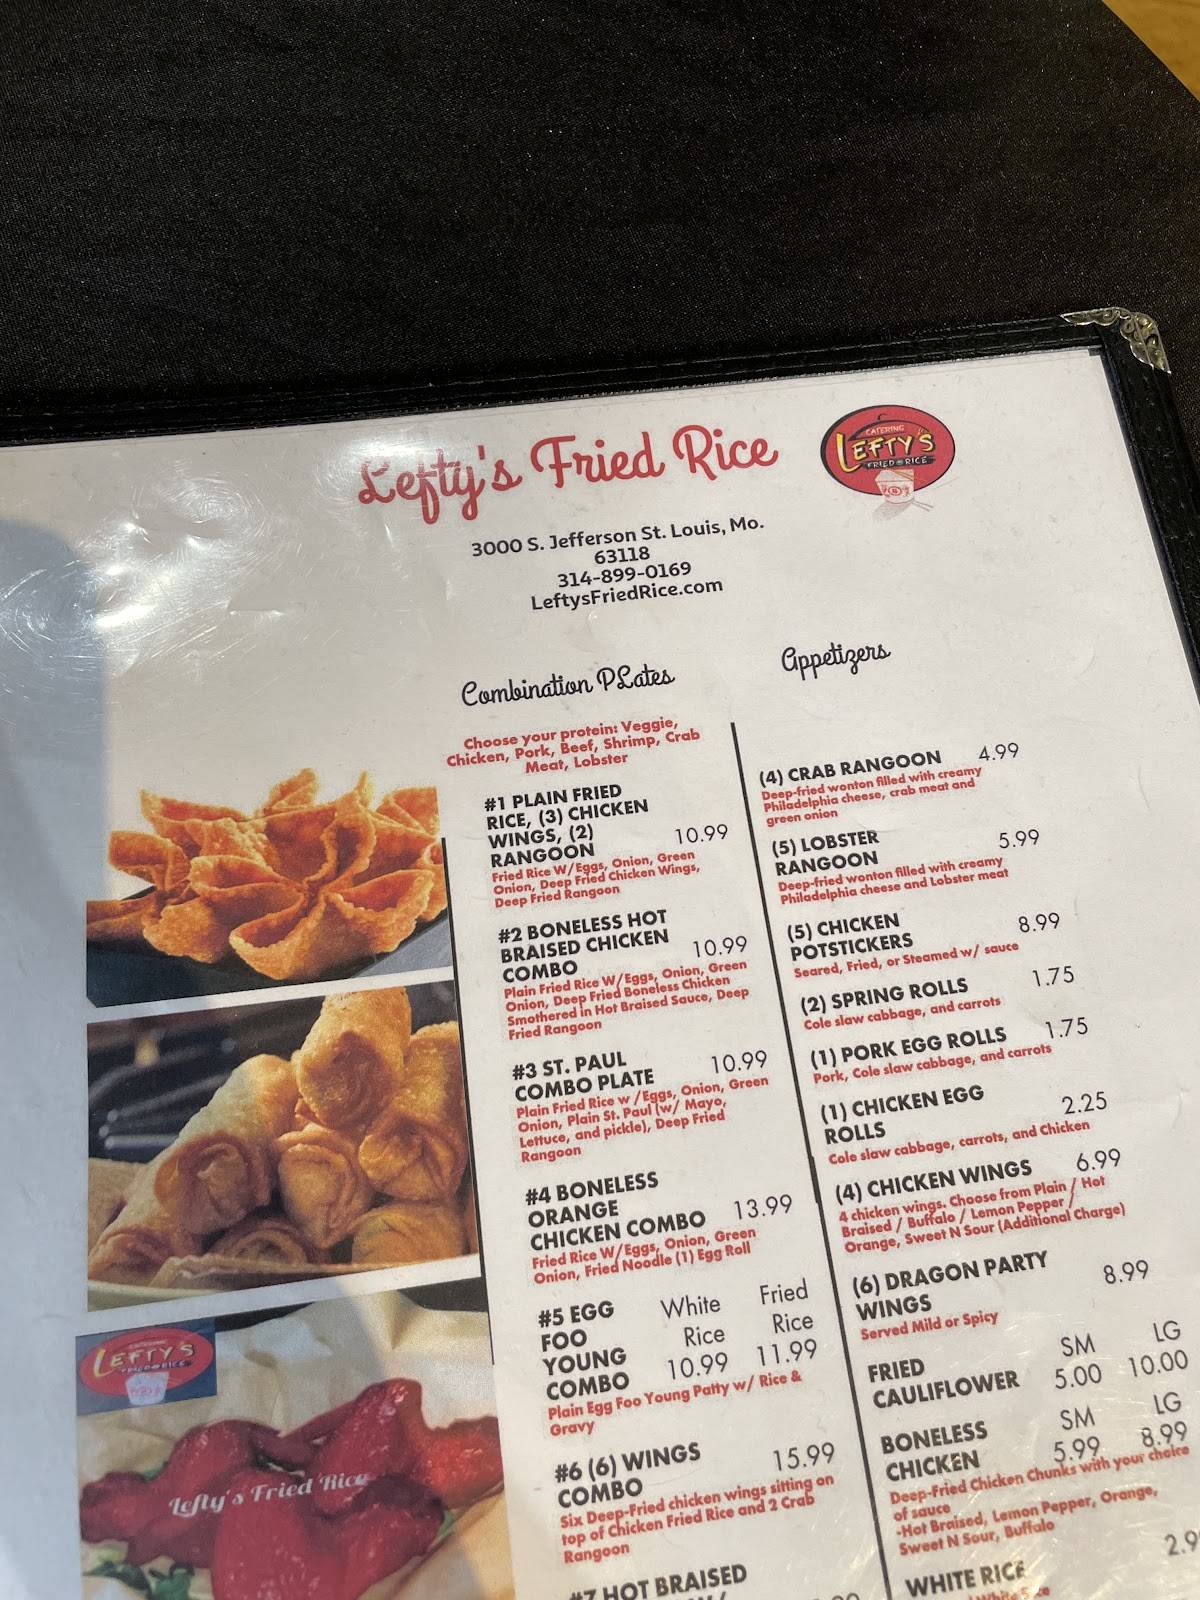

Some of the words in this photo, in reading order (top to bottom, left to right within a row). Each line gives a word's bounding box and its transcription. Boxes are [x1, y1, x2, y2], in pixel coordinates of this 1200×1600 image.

[837, 428, 936, 472] LEFTY'S
[357, 446, 523, 526] Lefty's
[530, 431, 666, 489] Fried
[672, 424, 779, 481] Rice
[471, 539, 523, 557] 3000
[528, 536, 545, 553] S.
[548, 527, 637, 552] Jefferson
[642, 524, 666, 541] St.
[670, 518, 727, 539] Louis,
[730, 515, 765, 534] Mo.
[594, 546, 650, 564] 63118
[557, 561, 692, 588] 314-899-0169
[531, 578, 724, 611] LeftysFriedRice.com
[462, 666, 594, 707] Combination
[447, 752, 509, 767] Chicken,
[515, 745, 554, 760] Pork,
[561, 739, 597, 754] Beef,
[604, 733, 660, 750] Shrimp,
[666, 729, 700, 742] Crab
[463, 736, 518, 750] Choose
[522, 731, 557, 746] your
[560, 725, 618, 742] protein:
[621, 717, 678, 735] Veggie,
[525, 759, 569, 774] Meat,
[574, 753, 628, 768] Lobster
[760, 769, 783, 787] (4)
[788, 765, 836, 782] CRAB
[840, 751, 942, 776] RANGOON
[979, 743, 1019, 761] 4.99
[485, 798, 505, 811] #1
[513, 790, 568, 808] PLAIN
[573, 784, 622, 801] FRIED
[762, 784, 825, 800] Deep-fried
[828, 780, 873, 792] wonton
[876, 773, 906, 787] filled
[908, 770, 935, 782] with
[938, 766, 982, 780] creamy
[486, 813, 531, 830] RICE,
[539, 809, 563, 826] (3)
[568, 799, 649, 820] CHICKEN
[489, 829, 561, 848] WINGS,
[569, 824, 593, 842] (2)
[491, 844, 595, 867] RANGOON
[675, 824, 728, 844] 10.99
[772, 839, 796, 856] (5)
[801, 830, 879, 852] LOBSTER
[999, 829, 1039, 849] 5.99
[775, 851, 878, 876] RANGOON
[498, 928, 522, 943] #2
[528, 915, 623, 941] BONELESS
[628, 910, 667, 928] HOT
[787, 924, 811, 942] (5)
[817, 913, 900, 936] CHICKEN
[1018, 912, 1060, 933] 8.99
[501, 943, 581, 964] BRAISED
[586, 929, 669, 952] CHICKEN
[693, 936, 747, 958] 10.99
[791, 933, 913, 961] POTSTICKERS
[794, 963, 843, 977] Seared,
[847, 958, 883, 972] Fried,
[887, 957, 899, 966] or
[903, 948, 958, 965] Steamed
[961, 944, 979, 959] w/
[985, 942, 1019, 954] sauce
[502, 960, 578, 983] COMBO
[801, 996, 826, 1015] (2)
[832, 986, 904, 1009] SPRING
[910, 978, 968, 998] ROLLS
[1033, 966, 1074, 987] 1.75
[804, 1018, 832, 1029] Cole
[835, 1013, 864, 1026] slaw
[867, 1006, 926, 1022] cabbage,
[930, 1002, 954, 1013] and
[958, 996, 1001, 1009] carrots
[810, 1049, 837, 1069] (1)
[841, 1042, 895, 1062] PORK
[902, 1036, 942, 1054] EGG
[947, 1027, 1007, 1047] ROLLS
[1046, 1017, 1088, 1039] 1.75
[512, 1066, 537, 1080] #3
[543, 1060, 570, 1076] ST.
[576, 1051, 626, 1072] PAUL
[515, 1079, 592, 1101] COMBO
[599, 1069, 654, 1091] PLATE
[711, 1051, 767, 1074] 10.99
[821, 1103, 846, 1124] (1)
[852, 1091, 938, 1117] CHICKEN
[942, 1085, 984, 1103] EGG
[1062, 1092, 1107, 1114] 2.25
[825, 1122, 886, 1144] ROLLS
[526, 1187, 551, 1205] #4
[557, 1172, 658, 1201] BONELESS
[836, 1183, 862, 1205] (4)
[867, 1170, 955, 1197] CHICKEN
[959, 1160, 1033, 1184] WINGS
[1077, 1149, 1120, 1172] 6.99
[528, 1200, 619, 1227] ORANGE
[530, 1223, 621, 1250] CHICKEN
[626, 1210, 706, 1237] COMBO
[734, 1194, 792, 1220] 13.99
[853, 1275, 880, 1298] (6)
[886, 1261, 979, 1290] DRAGON
[985, 1251, 1048, 1275] PARTY
[1103, 1260, 1149, 1284] 8.99
[538, 1307, 564, 1327] #5
[571, 1301, 615, 1323] EGG
[660, 1296, 721, 1319] White
[760, 1278, 808, 1305] Fried
[856, 1294, 932, 1320] WINGS
[541, 1330, 587, 1351] FOO
[684, 1326, 725, 1347] Rice
[772, 1314, 813, 1333] Rice
[861, 1324, 908, 1340] Served
[912, 1318, 941, 1332] Mild
[946, 1317, 959, 1328] or
[963, 1311, 998, 1327] Spicy
[1061, 1334, 1095, 1357] SM
[1154, 1321, 1181, 1342] LG
[542, 1347, 627, 1375] YOUNG
[547, 1372, 629, 1400] COMBO
[668, 1353, 728, 1380] 10.99
[757, 1339, 817, 1366] 11.99
[868, 1359, 925, 1382] FRIED
[873, 1370, 1019, 1408] CAULIFLOWER
[1055, 1364, 1102, 1389] 5.00
[1129, 1350, 1188, 1377] 10.00
[548, 1405, 583, 1419] Plain
[587, 1401, 612, 1415] Egg
[616, 1396, 641, 1410] Foo
[644, 1389, 690, 1405] Young
[693, 1382, 729, 1398] Patty
[733, 1377, 755, 1393] w/
[759, 1373, 787, 1387] Rice
[1061, 1407, 1095, 1430] SM
[1154, 1392, 1181, 1414] LG
[550, 1421, 595, 1436] Gravy
[881, 1421, 988, 1454] BONELESS
[555, 1463, 582, 1483] #6
[589, 1455, 617, 1479] (6)
[622, 1442, 700, 1471] WINGS
[773, 1443, 834, 1472] 15.99
[886, 1451, 980, 1481] CHICKEN
[1054, 1437, 1100, 1463] 5.99
[1142, 1422, 1188, 1447] 8.99
[169, 1493, 244, 1518] Lefty's
[250, 1480, 312, 1503] Fried
[319, 1472, 368, 1491] Rice
[558, 1478, 643, 1508] COMBO
[906, 1569, 975, 1596] WHITE
[981, 1561, 1025, 1587] RICE
[1165, 1531, 1200, 1556] 2.9
[603, 1580, 649, 1600] HOT
[656, 1564, 747, 1597] BRAISED
